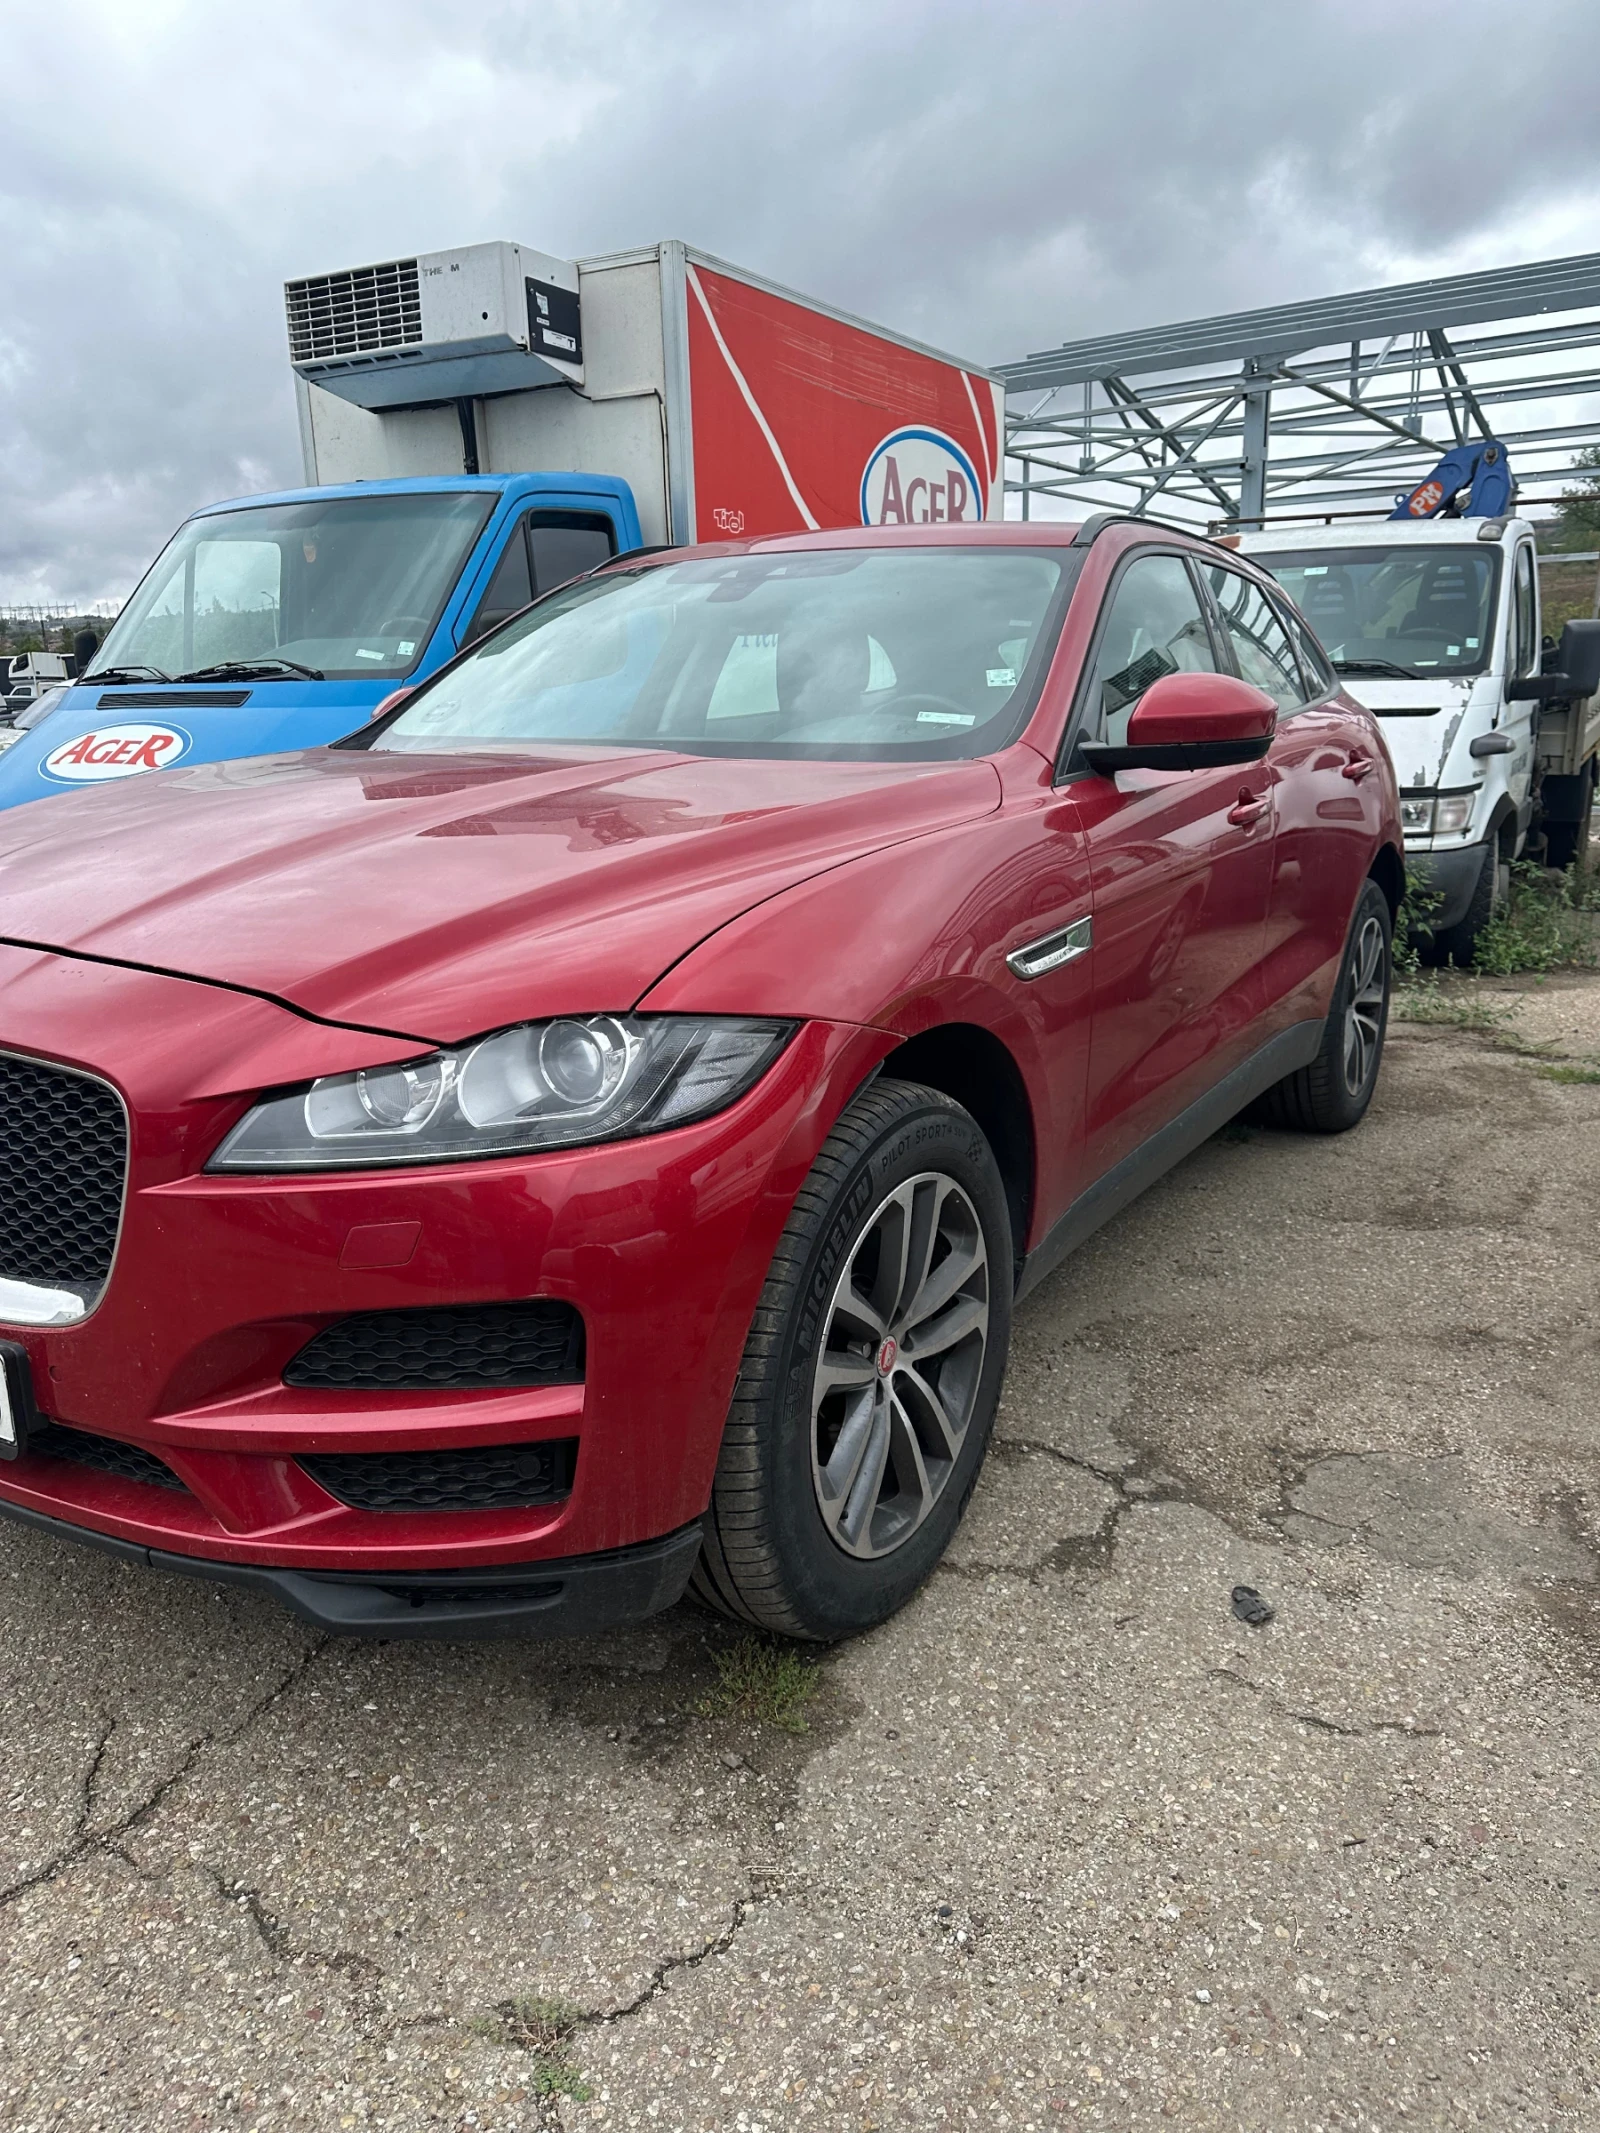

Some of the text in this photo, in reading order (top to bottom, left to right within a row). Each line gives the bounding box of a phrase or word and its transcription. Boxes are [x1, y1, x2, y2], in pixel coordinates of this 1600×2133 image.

[880, 455, 967, 525] AGER
[1410, 483, 1442, 516] PM
[50, 735, 174, 768] AGER
[882, 1135, 911, 1172] PILOT
[915, 1124, 947, 1145] SPORT
[798, 1176, 870, 1353] MICHELIN
